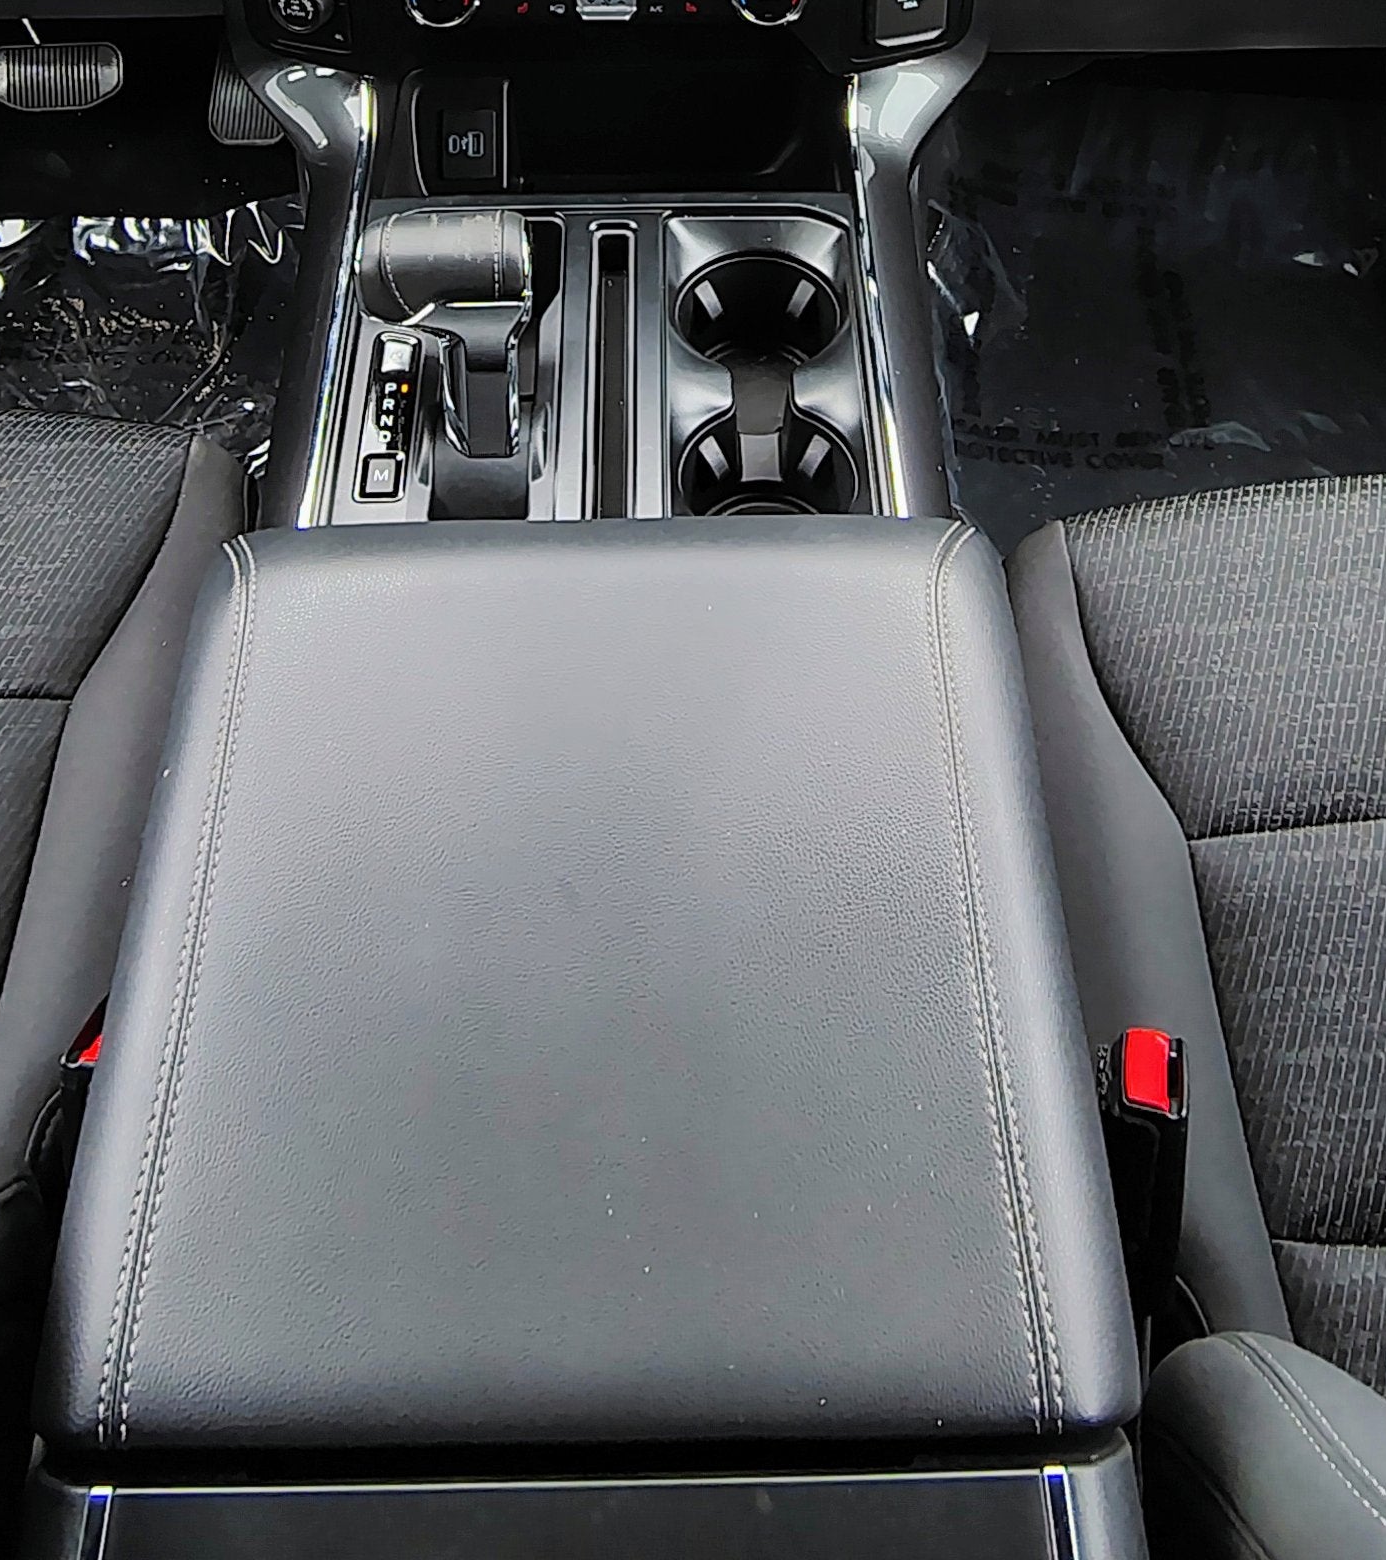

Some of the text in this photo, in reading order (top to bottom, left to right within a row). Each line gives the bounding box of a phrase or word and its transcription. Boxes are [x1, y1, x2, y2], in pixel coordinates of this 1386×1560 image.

[650, 5, 663, 13] A/C
[385, 383, 397, 394] P
[382, 399, 395, 410] R
[380, 415, 393, 426] N
[379, 430, 391, 443] D
[1036, 431, 1099, 447] MUST
[373, 469, 389, 482] M
